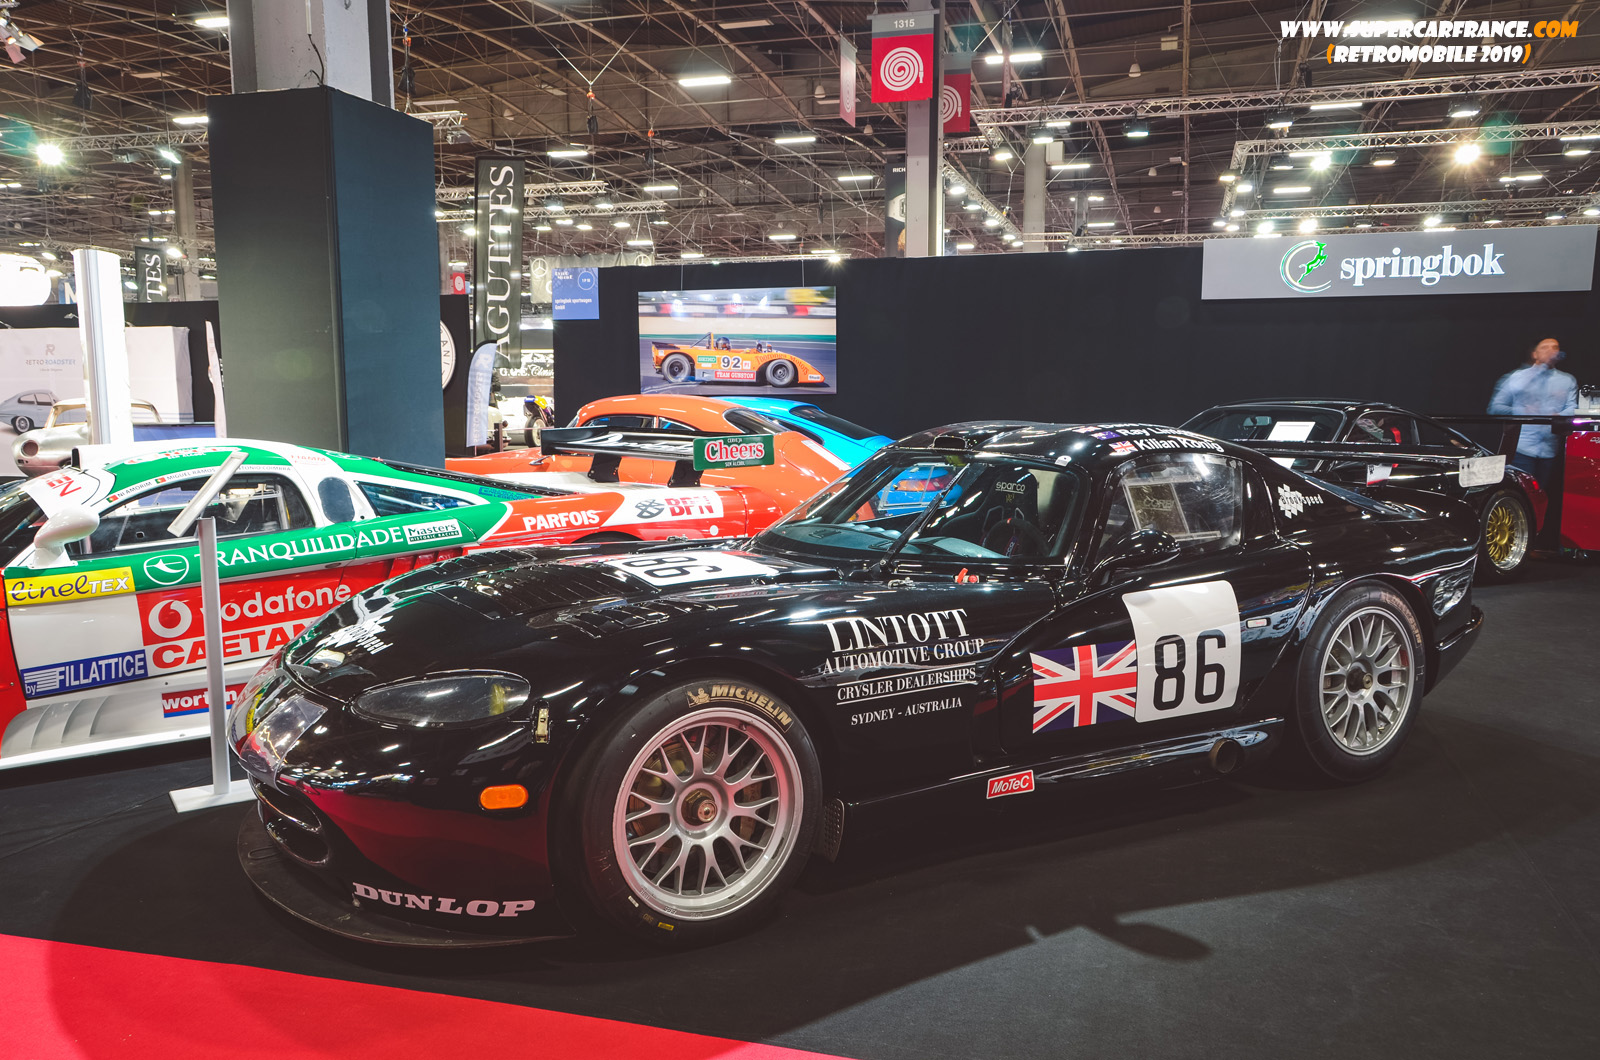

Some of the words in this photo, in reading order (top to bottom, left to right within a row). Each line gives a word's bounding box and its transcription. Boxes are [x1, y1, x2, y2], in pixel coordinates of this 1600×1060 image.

[893, 19, 915, 28] 1315
[486, 165, 514, 362] AGUTTES
[1340, 243, 1505, 287] springbok
[722, 356, 741, 368] 92
[705, 439, 765, 462] Cheers
[995, 481, 1026, 492] sparco
[408, 523, 457, 537] Masters
[523, 509, 600, 532] PARFOIS
[194, 526, 404, 569] RANQUILIDADE
[622, 556, 723, 579] 86
[824, 608, 970, 653] LINTOTT
[55, 653, 145, 689] FILLATTICE
[823, 645, 931, 675] AUTOMOTIVE
[933, 637, 985, 660] GROUP
[1152, 629, 1227, 711] 86
[25, 683, 37, 695] by
[837, 680, 893, 701] CRYSLER
[896, 667, 976, 691] DEALERSHIPS
[162, 689, 238, 710] wortn
[711, 684, 793, 726] MICHELIN
[851, 707, 895, 726] SYDNEY
[904, 696, 963, 717] AUSTRALIA
[991, 774, 1030, 795] MoTeC
[352, 882, 536, 917] DUNLOP
